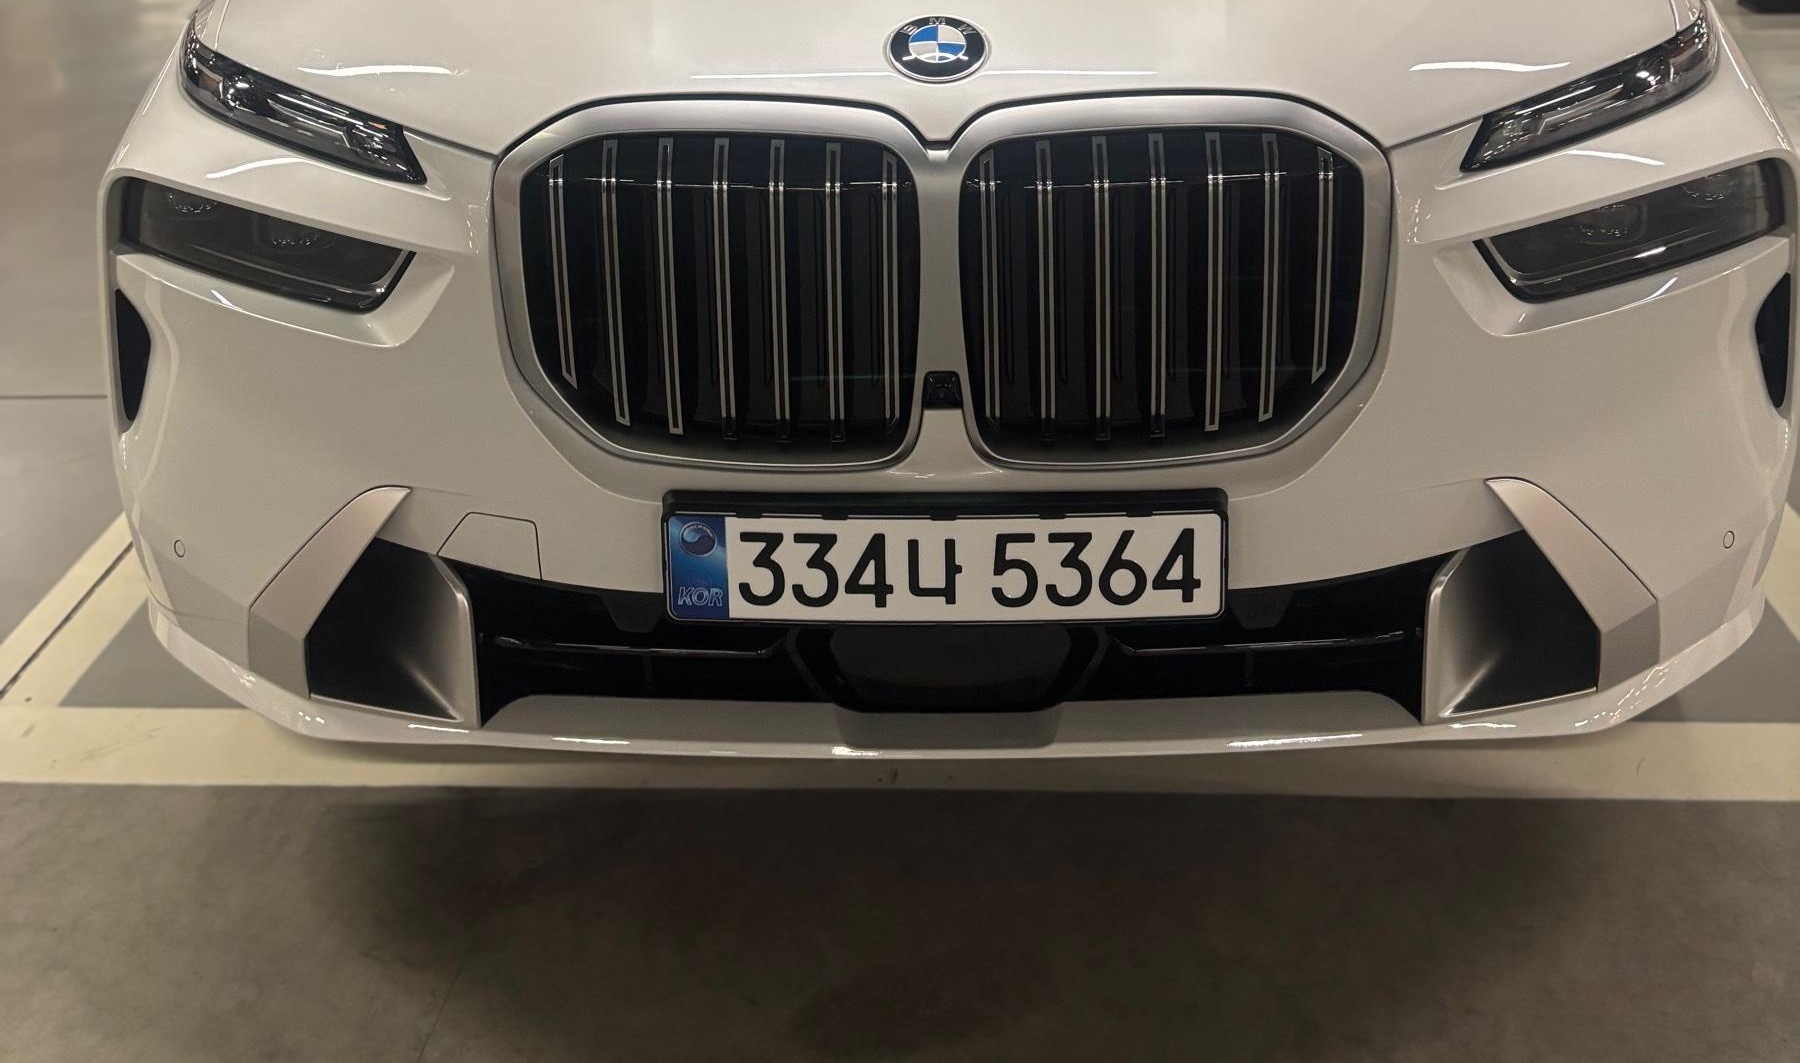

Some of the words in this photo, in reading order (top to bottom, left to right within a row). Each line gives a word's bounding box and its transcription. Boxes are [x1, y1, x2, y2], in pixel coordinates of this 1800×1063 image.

[899, 17, 976, 35] BMW
[738, 532, 963, 608] 334나
[991, 527, 1201, 608] 5364
[678, 587, 723, 606] KOR
